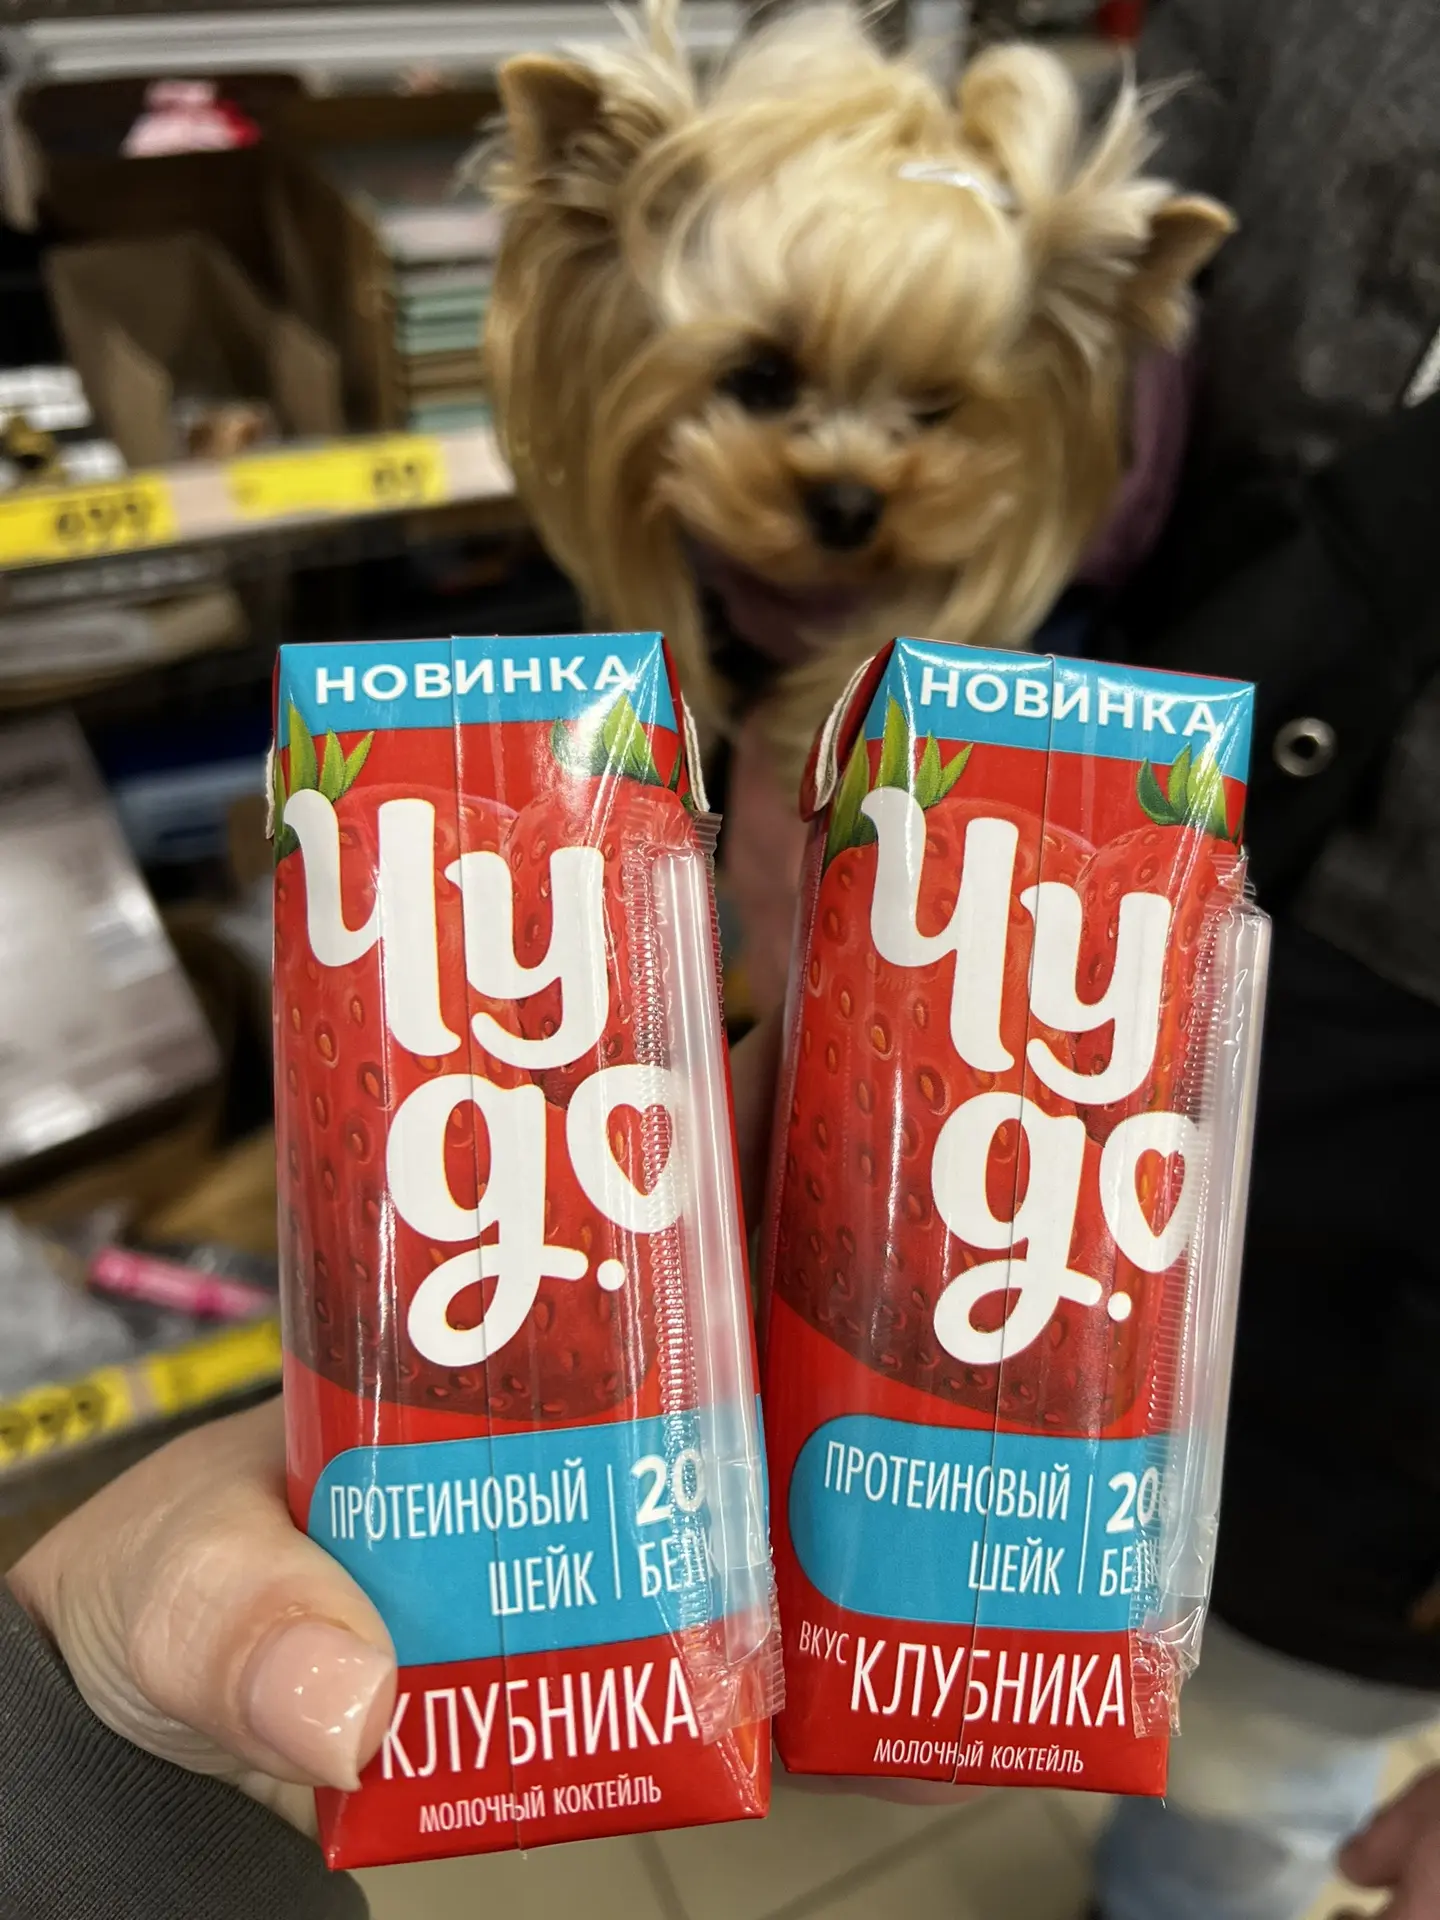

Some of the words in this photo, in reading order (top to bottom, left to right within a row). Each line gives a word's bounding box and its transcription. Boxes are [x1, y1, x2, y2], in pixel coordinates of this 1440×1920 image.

[315, 655, 638, 705] НОВИНКА
[919, 666, 1222, 740] НОВИНКА
[329, 1457, 589, 1541] ПРОТЕИНОВЫЙ
[630, 1448, 705, 1527] 20
[824, 1440, 1071, 1522] ПРОТЕИНОВЫЙ
[1106, 1466, 1159, 1534] 20
[488, 1544, 598, 1617] ШЕЙК
[967, 1537, 1066, 1597] ШЕЙК
[798, 1619, 849, 1665] ВКУС
[849, 1635, 1126, 1728] КЛУБНИКА
[382, 1656, 699, 1781] КЛУБНИКА
[873, 1737, 984, 1768] МОЛОЧНЫЙ
[989, 1741, 1085, 1774] КОКТЕЙЛЬ
[418, 1786, 546, 1835] МОЛОЧНЫЙ
[553, 1772, 662, 1816] КОКТЕЙЛЬ
